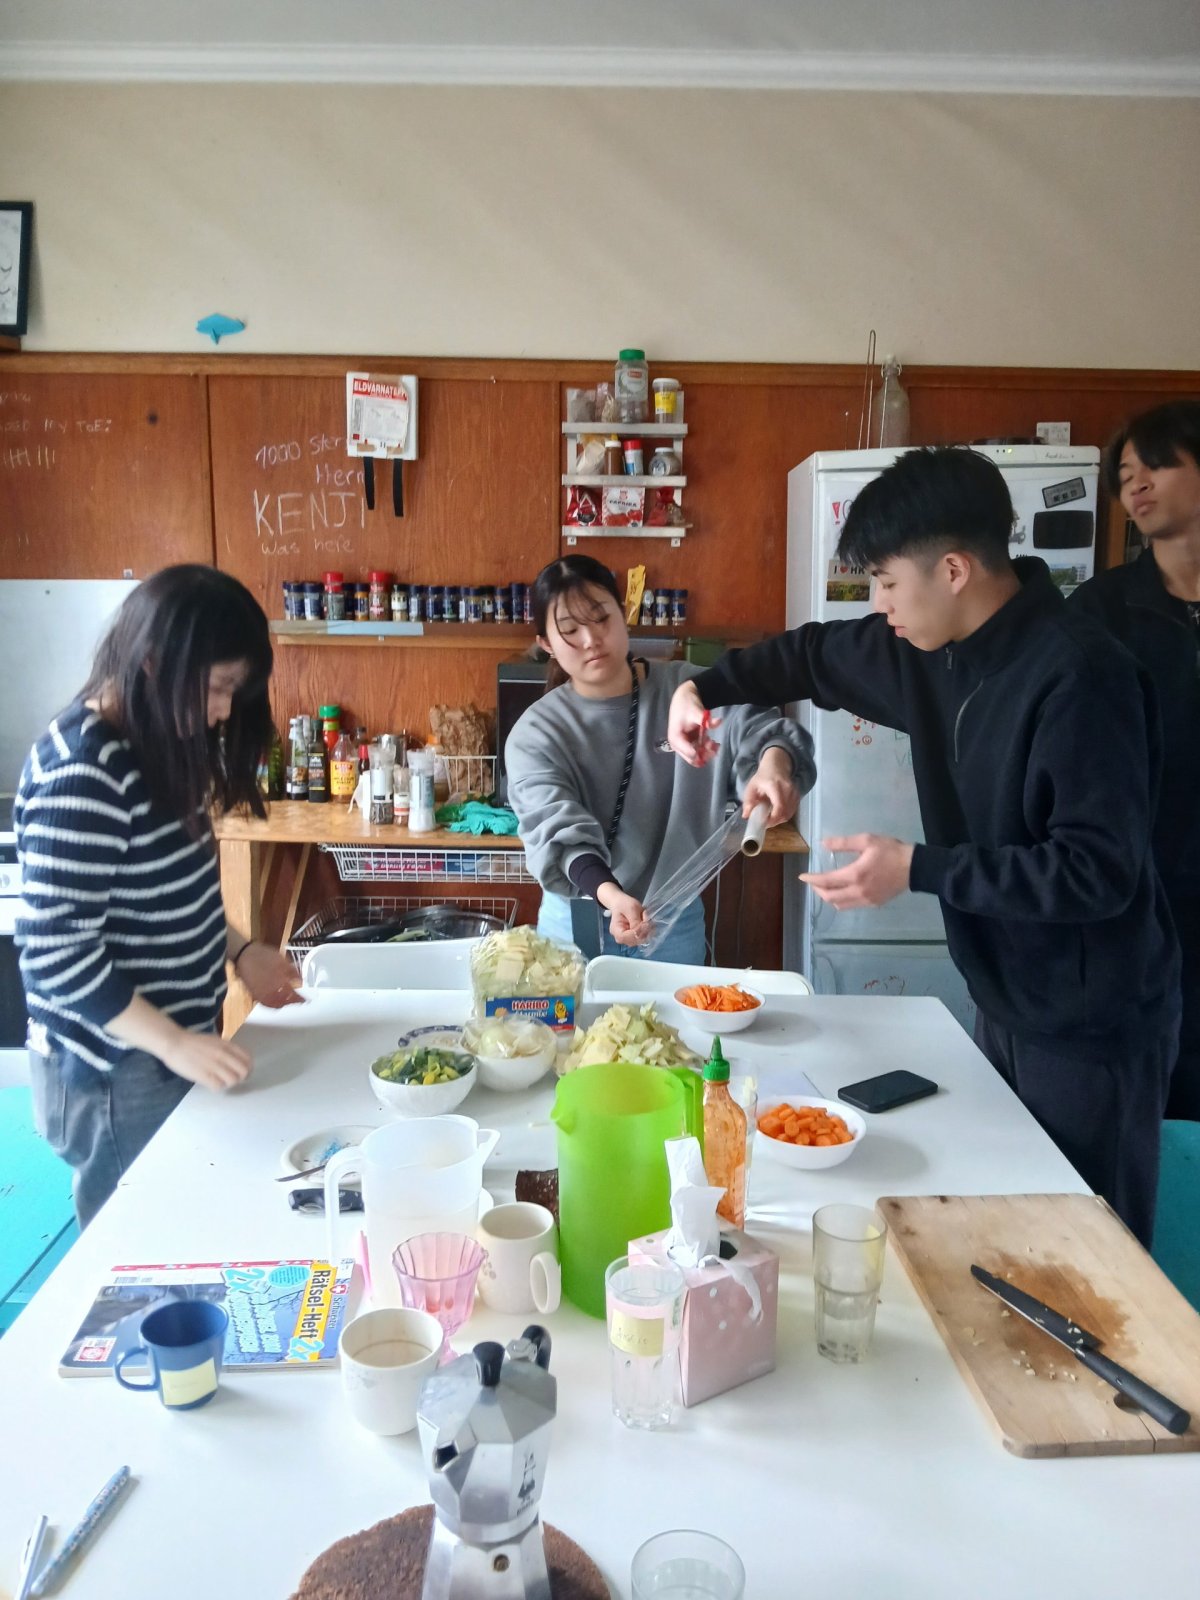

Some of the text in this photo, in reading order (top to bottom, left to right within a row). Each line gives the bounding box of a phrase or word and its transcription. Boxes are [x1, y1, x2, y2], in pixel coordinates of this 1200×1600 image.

[255, 441, 301, 469] 1000
[253, 489, 364, 537] KENJI
[314, 536, 355, 553] here
[512, 1000, 549, 1010] HARIBO
[299, 1270, 330, 1339] Rätsel-Heft
